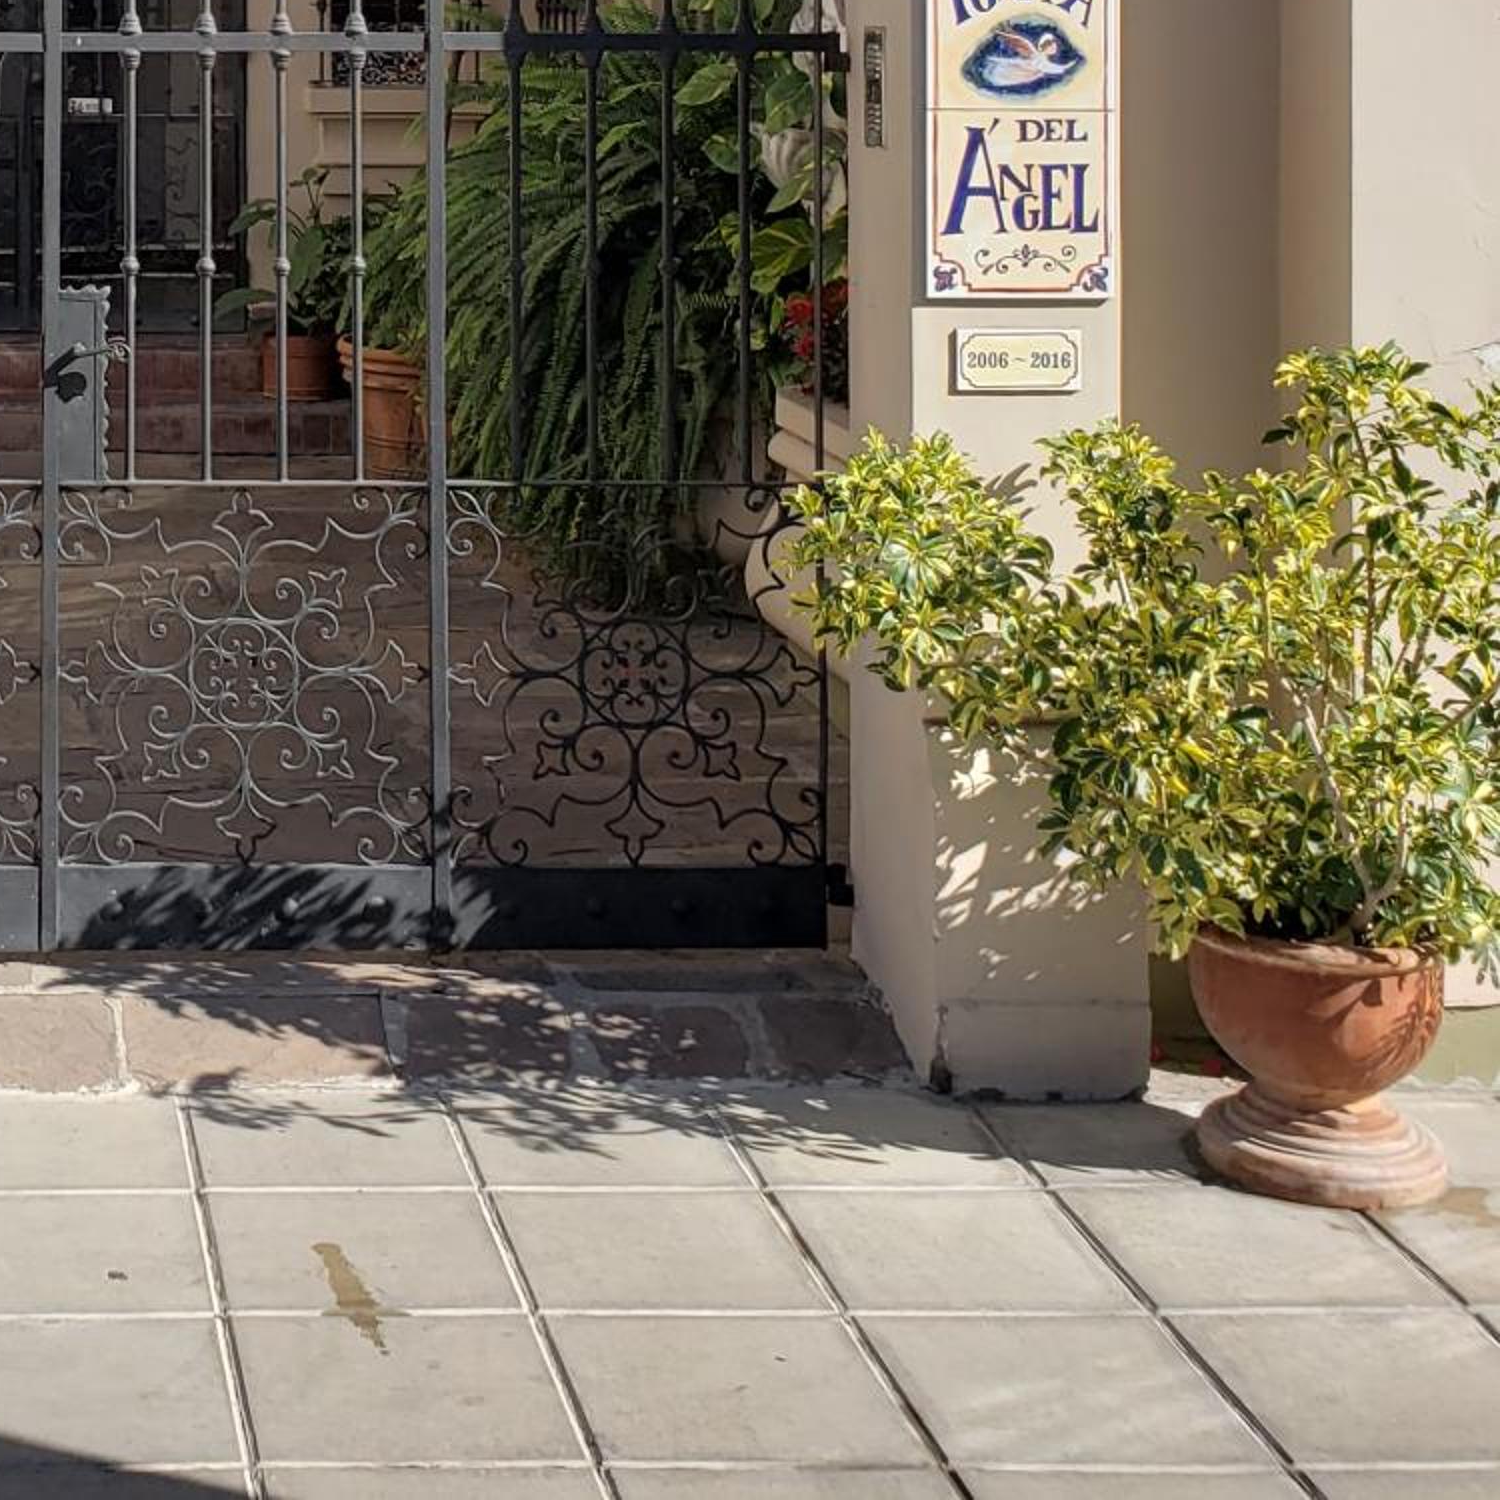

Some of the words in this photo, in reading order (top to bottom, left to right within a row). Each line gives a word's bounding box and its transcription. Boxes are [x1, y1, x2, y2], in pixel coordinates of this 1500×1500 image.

[1015, 118, 1089, 143] DEL
[966, 351, 1009, 369] 2006
[1030, 351, 1072, 369] 2016
